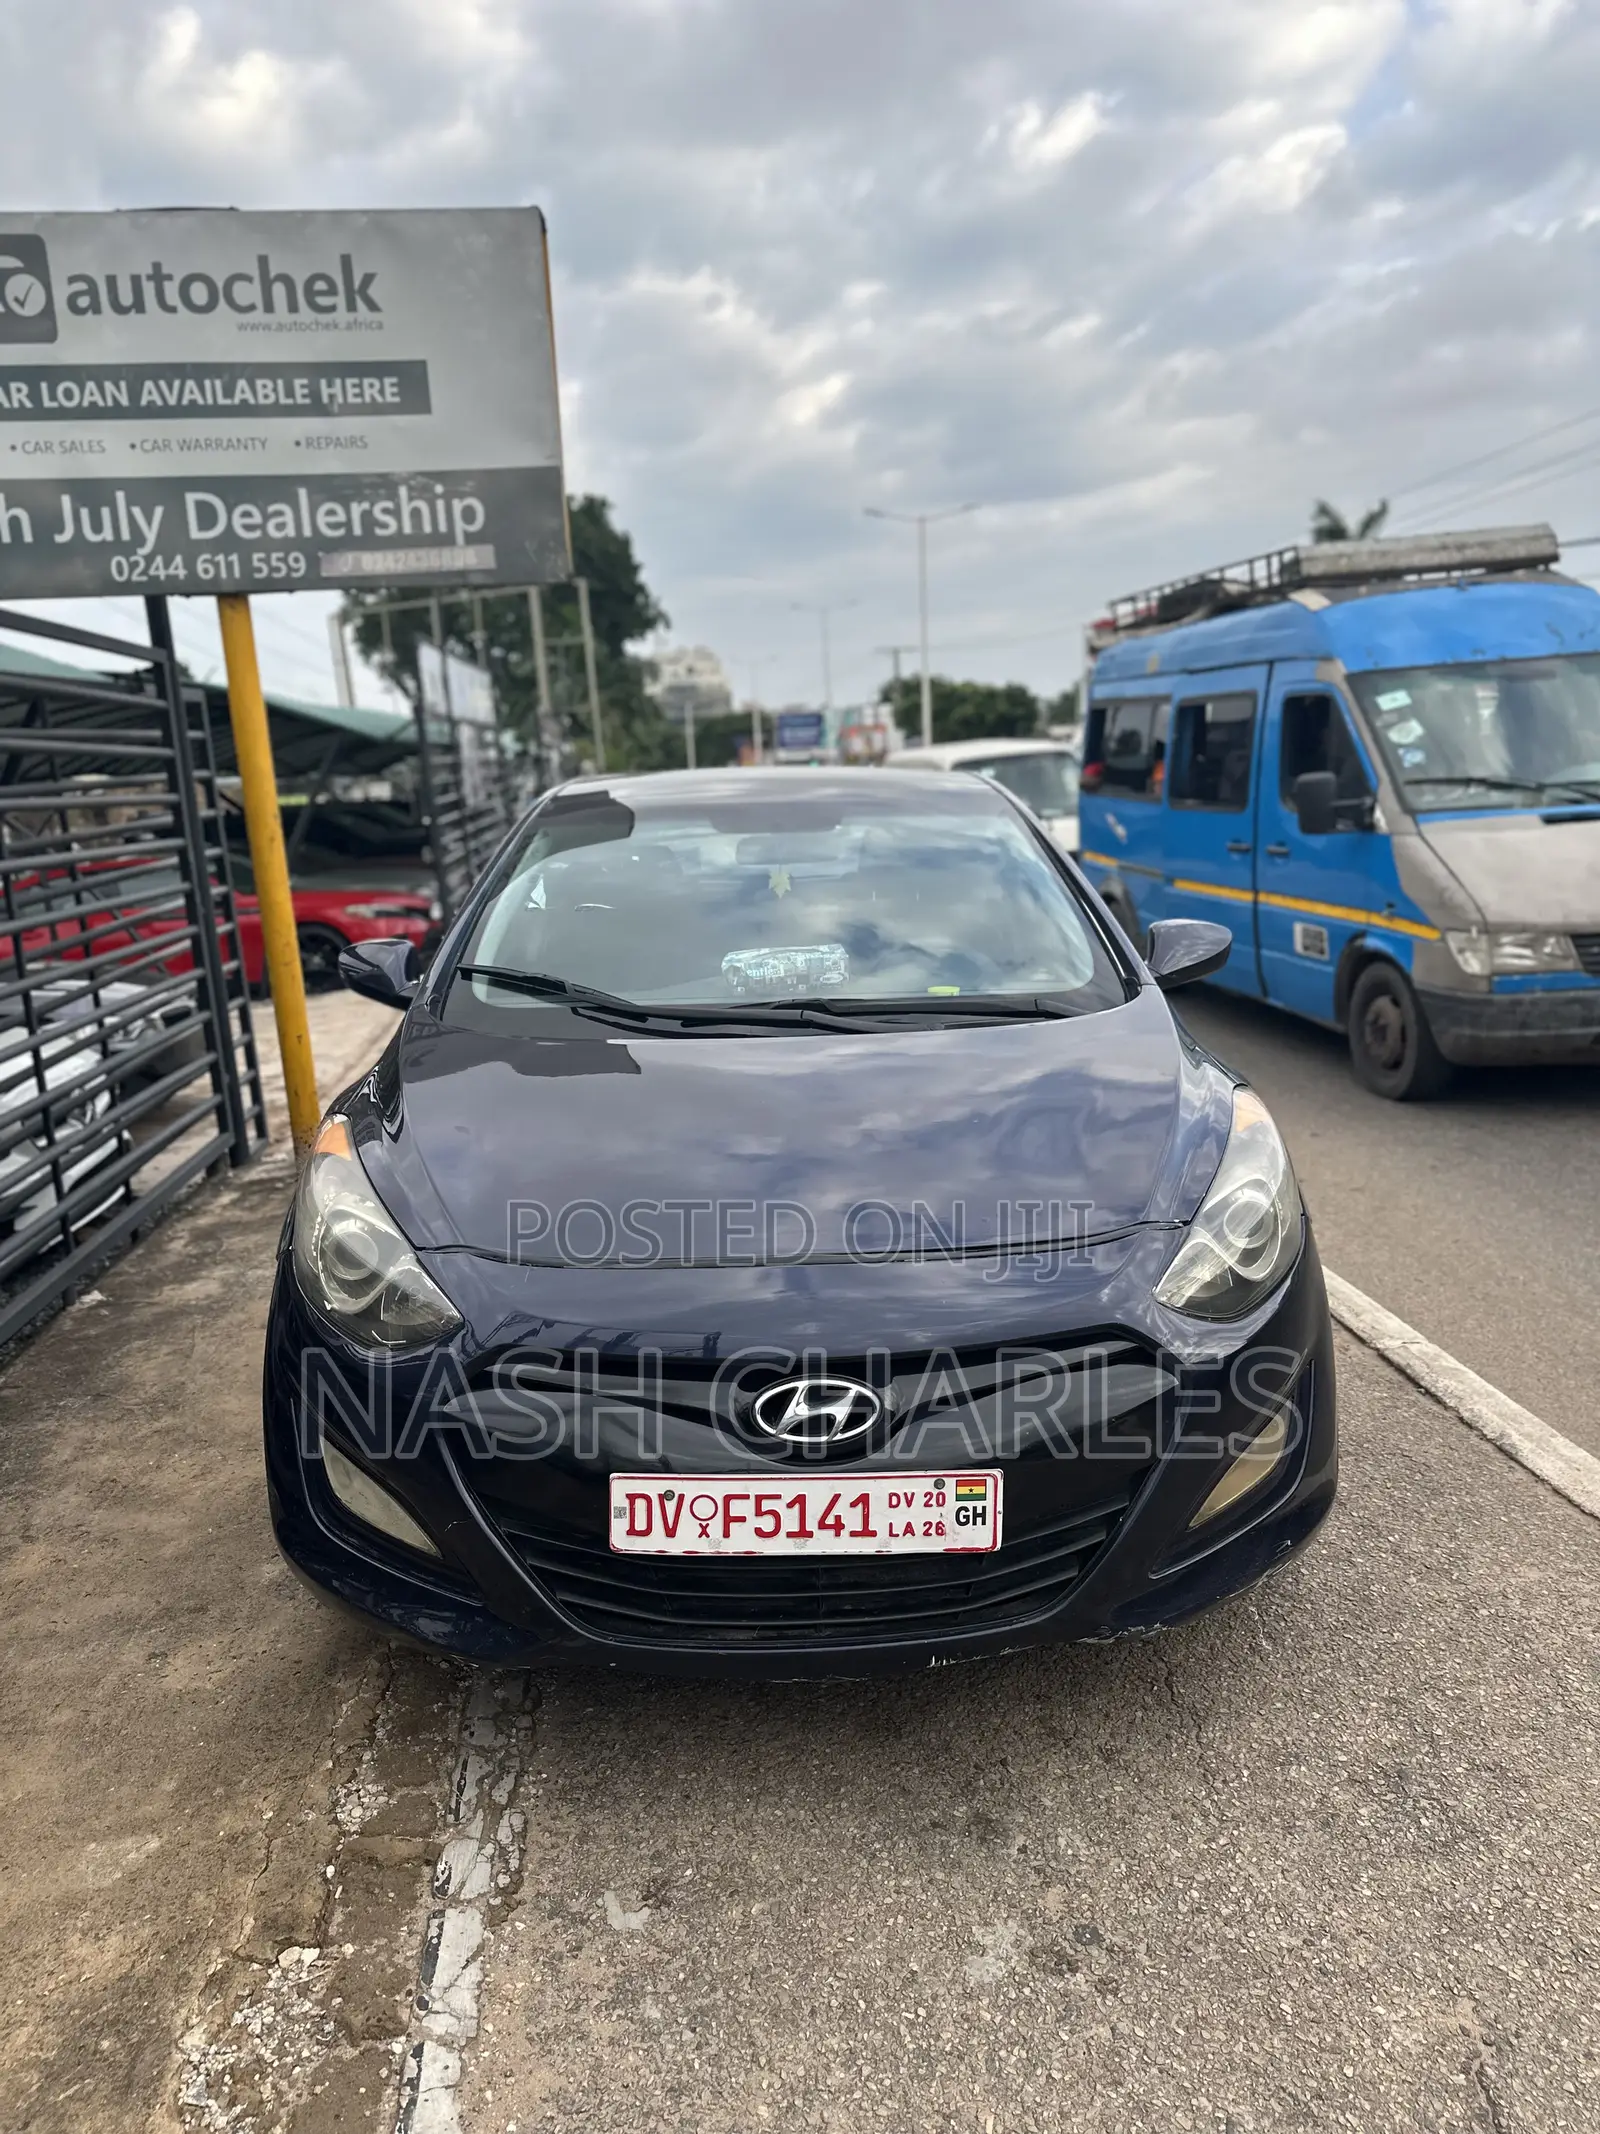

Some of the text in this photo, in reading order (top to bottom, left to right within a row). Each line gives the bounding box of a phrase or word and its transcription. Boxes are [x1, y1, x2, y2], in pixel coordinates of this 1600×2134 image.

[66, 254, 382, 316] autochek
[236, 318, 384, 334] www.autochek.africa
[40, 380, 129, 408] LOAN
[140, 378, 312, 407] AVAILABLE
[320, 377, 401, 404] HERE
[21, 439, 106, 455] CAR SALES
[140, 436, 268, 453] CAR WARRANTY
[305, 435, 368, 450] REPAIRS
[54, 490, 164, 555] July
[184, 484, 485, 546] Dealership
[111, 552, 307, 582] 0244 611 559
[888, 1491, 946, 1509] DV 20
[955, 1505, 987, 1527] GH
[888, 1520, 946, 1537] LA 26
